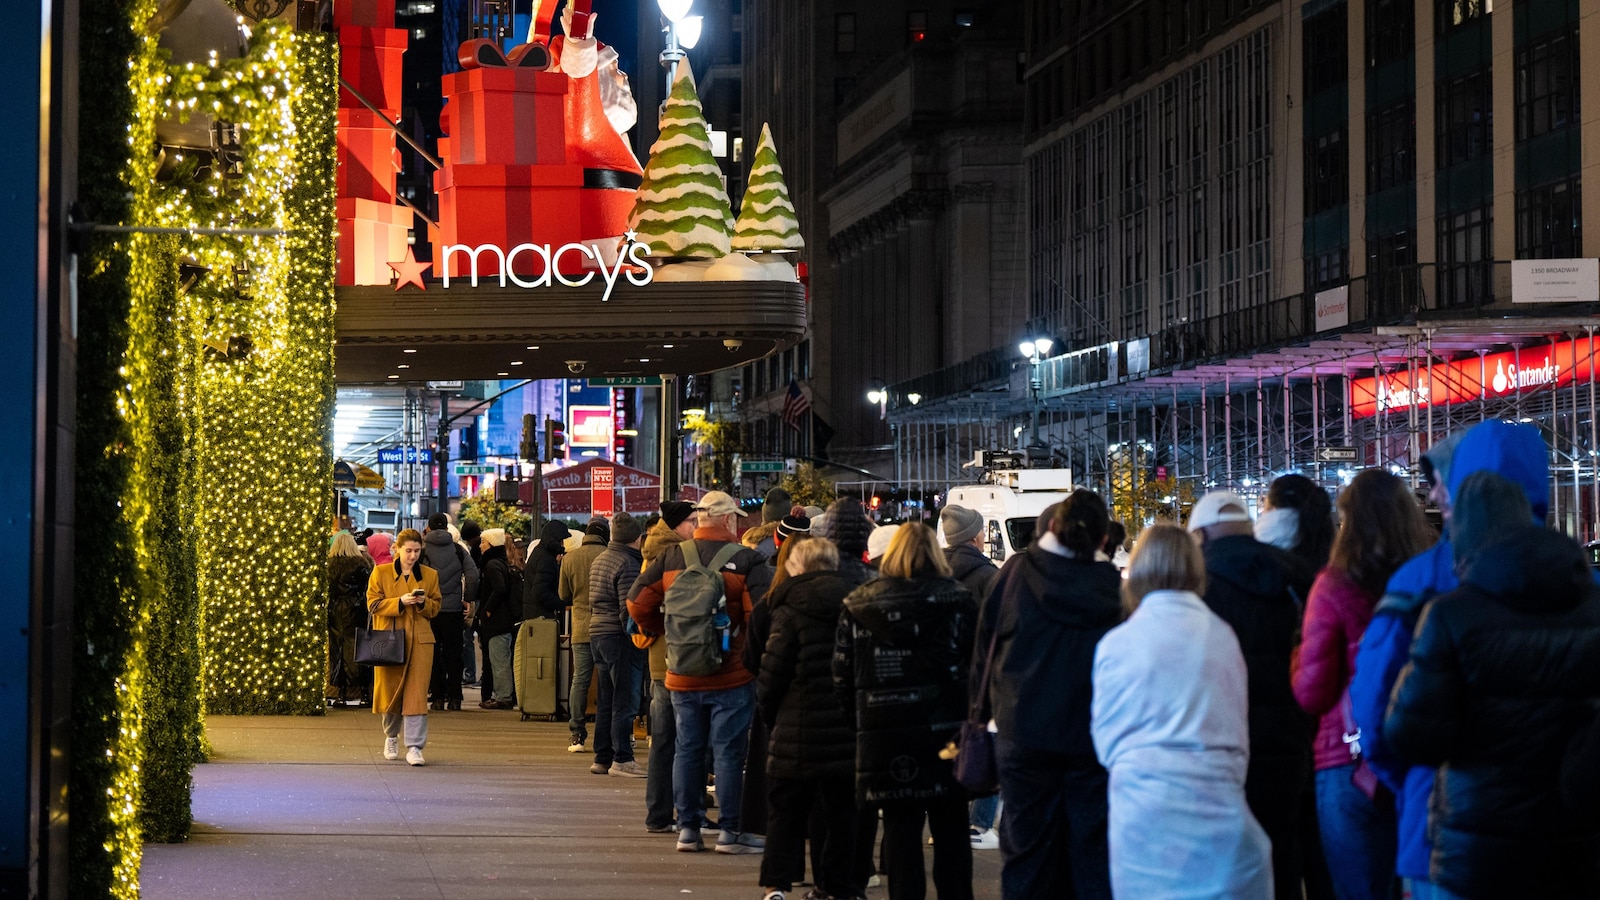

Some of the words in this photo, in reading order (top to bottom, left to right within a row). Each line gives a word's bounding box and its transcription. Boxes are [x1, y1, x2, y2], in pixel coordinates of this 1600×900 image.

[1323, 301, 1346, 317] Santander
[381, 452, 402, 461] West
[403, 452, 417, 461] 5th
[420, 452, 428, 461] St
[629, 473, 653, 486] Bar
